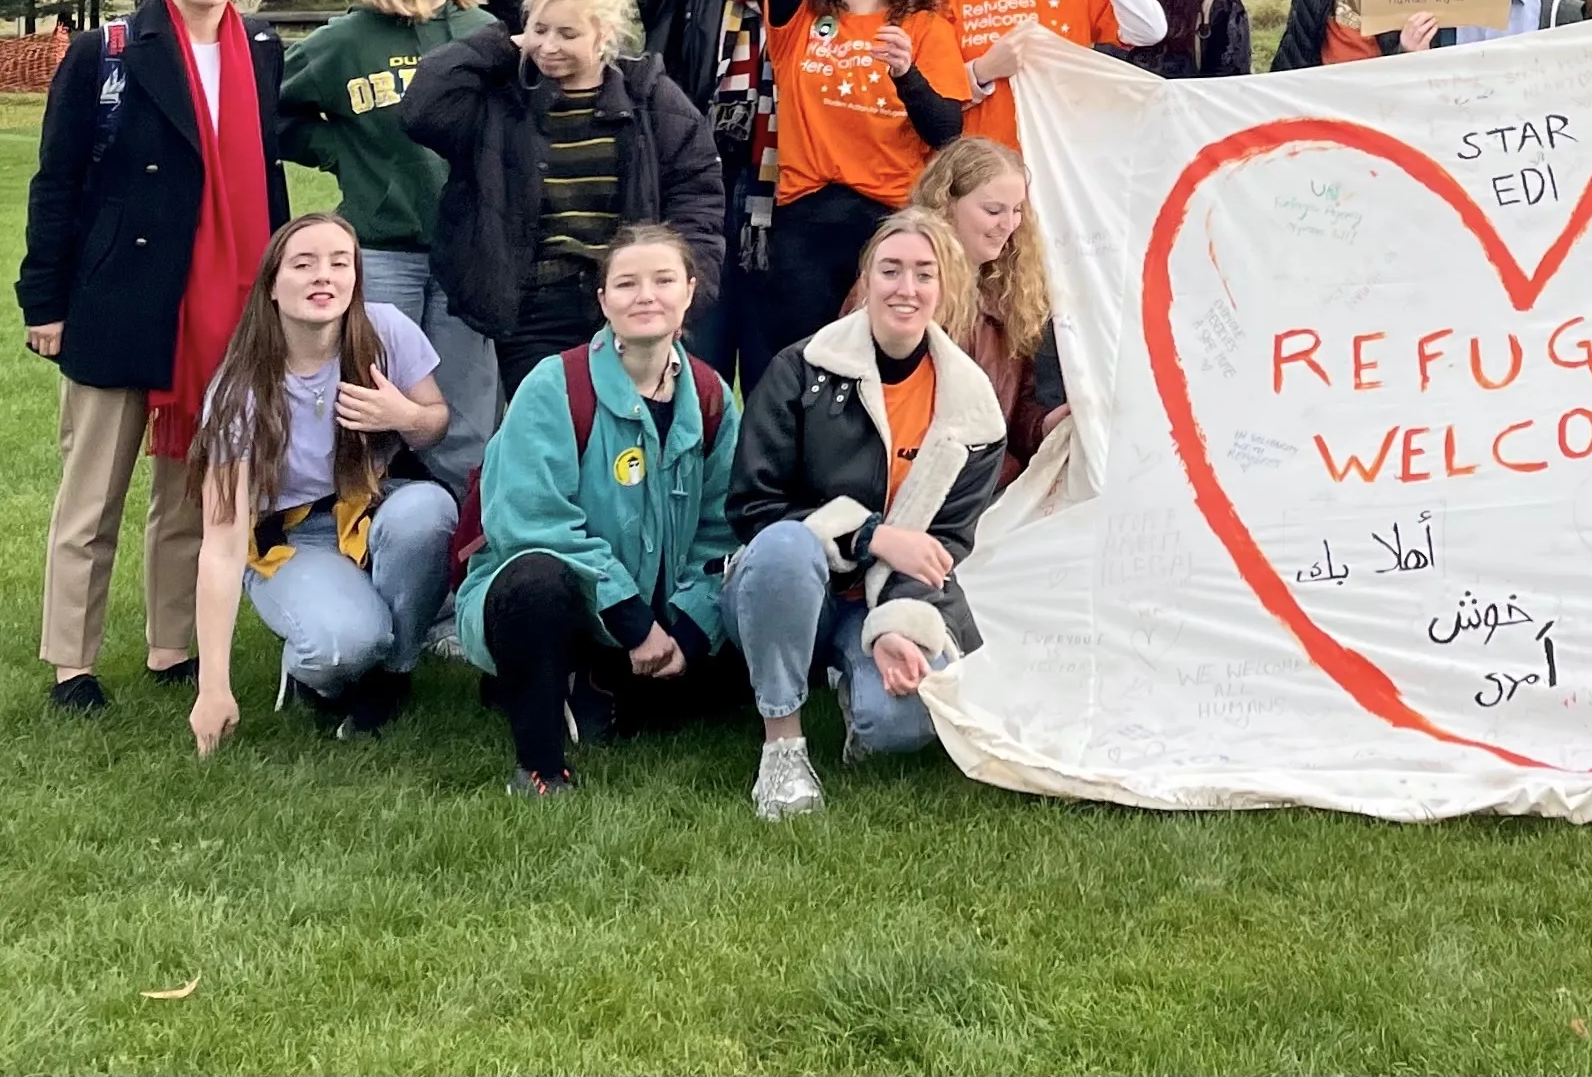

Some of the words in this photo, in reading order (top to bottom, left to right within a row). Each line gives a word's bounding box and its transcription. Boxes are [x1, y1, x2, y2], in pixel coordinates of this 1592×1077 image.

[961, 31, 1000, 49] Here
[1457, 114, 1579, 160] STAR
[1491, 162, 1560, 207] EDI
[1429, 590, 1533, 644] خوش
[1177, 664, 1213, 688] WE
